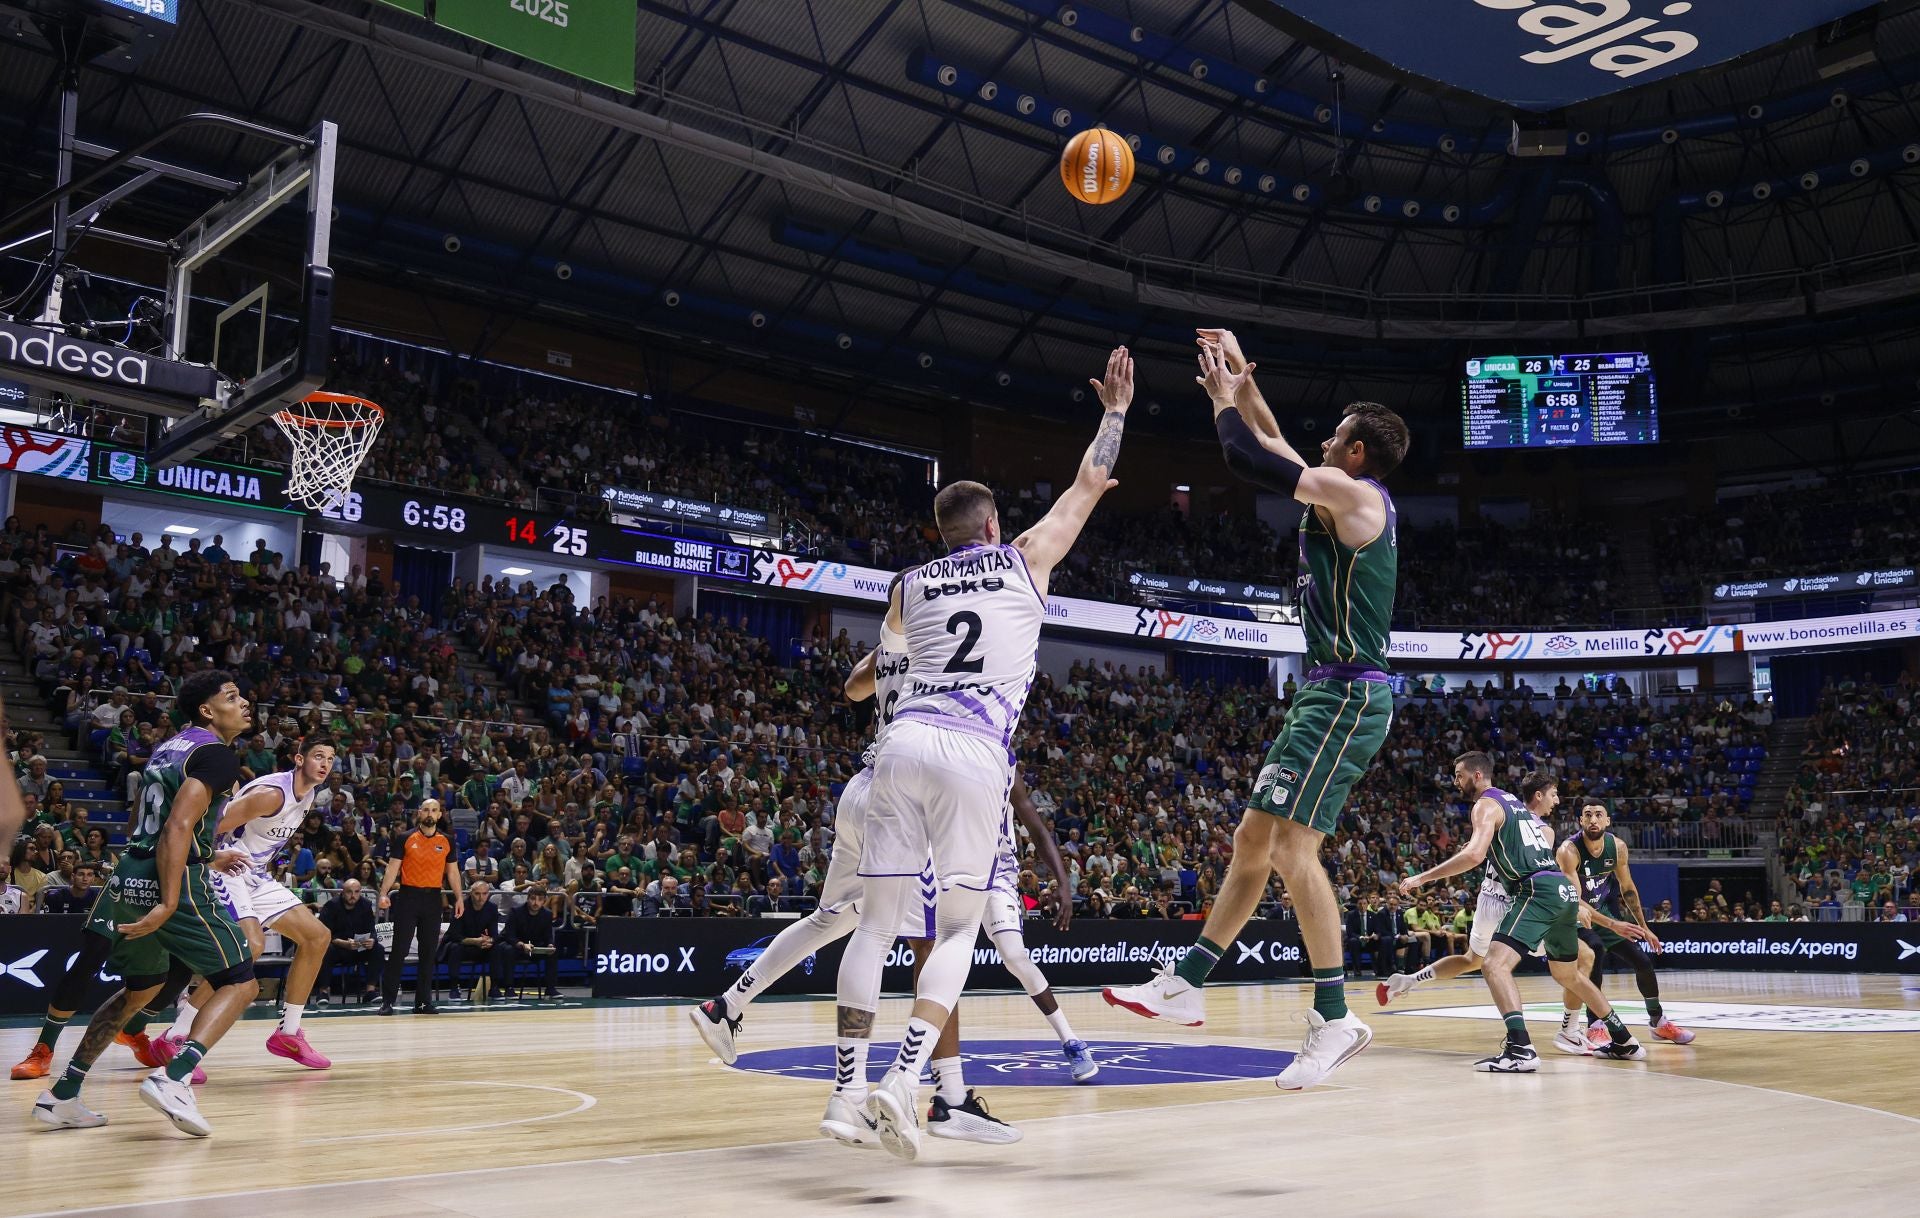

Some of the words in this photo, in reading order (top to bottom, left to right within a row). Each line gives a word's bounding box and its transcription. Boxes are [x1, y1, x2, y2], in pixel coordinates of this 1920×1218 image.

[1484, 363, 1516, 372] UNICAJA
[1525, 361, 1542, 373] 26
[1549, 359, 1565, 371] VS
[1574, 359, 1591, 371] 25
[1546, 393, 1577, 407] 6:58
[1540, 423, 1547, 433] 1
[1571, 422, 1579, 432] 0
[158, 465, 261, 501] UNICAJA
[321, 489, 363, 522] 26
[403, 500, 466, 533] 6:58
[505, 517, 537, 545] 14
[552, 525, 588, 557] 25
[673, 541, 713, 560] SURNE
[635, 550, 671, 568] BILBAO
[673, 556, 712, 573] BASKET
[916, 550, 1013, 580] NORMANTAS
[1800, 575, 1839, 584] Fundación
[1874, 568, 1914, 578] Fundación
[1730, 581, 1768, 591] Fundación
[1800, 583, 1829, 592] Unicaja
[1874, 576, 1903, 586] Unicaja
[924, 581, 979, 601] bbk
[1200, 583, 1226, 595] Unicaja
[1255, 589, 1280, 600] Unicaja
[1730, 589, 1758, 598] Unicaja
[1224, 626, 1268, 643] Melilla
[1747, 620, 1907, 643] www.bonosmelilla.es
[942, 610, 985, 674] 2
[1585, 638, 1639, 651] Melilla
[132, 782, 165, 836] 13
[1518, 819, 1551, 851] 45
[124, 877, 160, 890] COSTA
[123, 888, 138, 897] DEL
[139, 890, 160, 899] SOL
[125, 897, 159, 908] MÁLAGA
[677, 947, 696, 972] X
